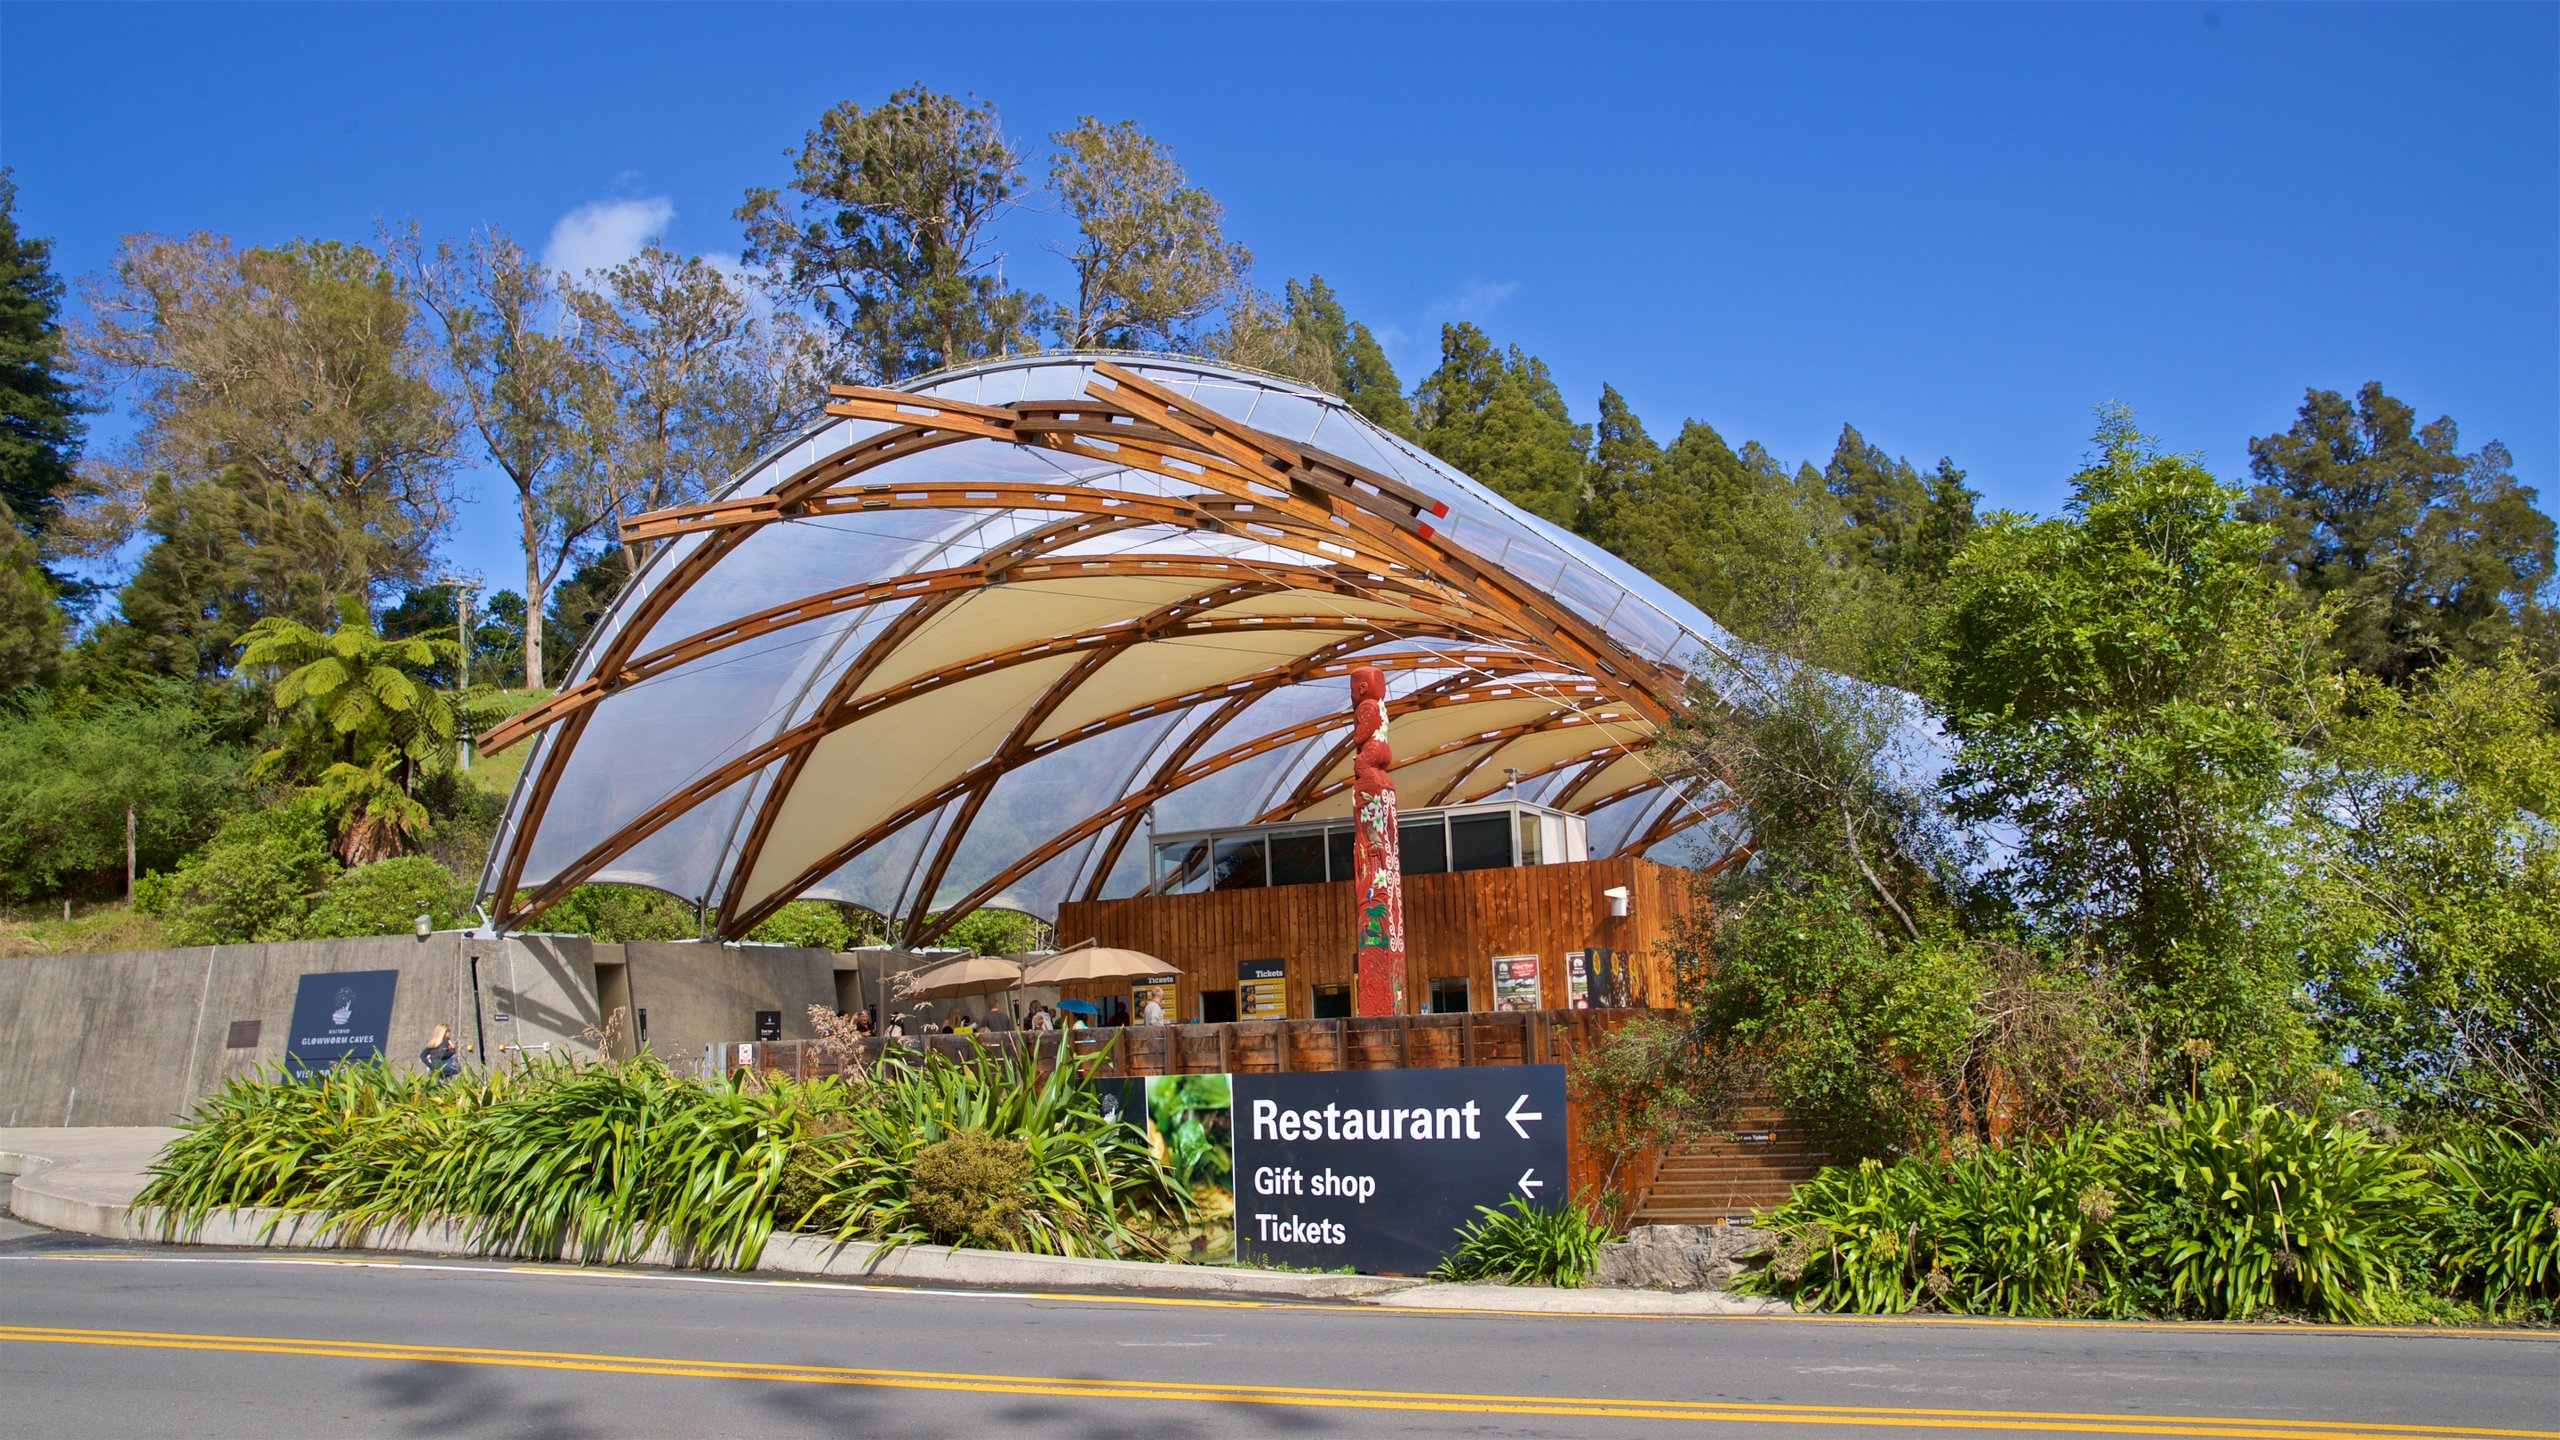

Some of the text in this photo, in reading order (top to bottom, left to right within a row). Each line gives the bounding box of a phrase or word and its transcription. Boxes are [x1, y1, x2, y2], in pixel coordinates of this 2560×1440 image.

[1148, 976, 1174, 984] Tickets
[1255, 970, 1284, 978] Tickets
[349, 1035, 374, 1043] CAVES
[1253, 1099, 1481, 1141] Restaurant
[1254, 1166, 1376, 1204] Gift shop
[1255, 1213, 1346, 1244] Tickets
